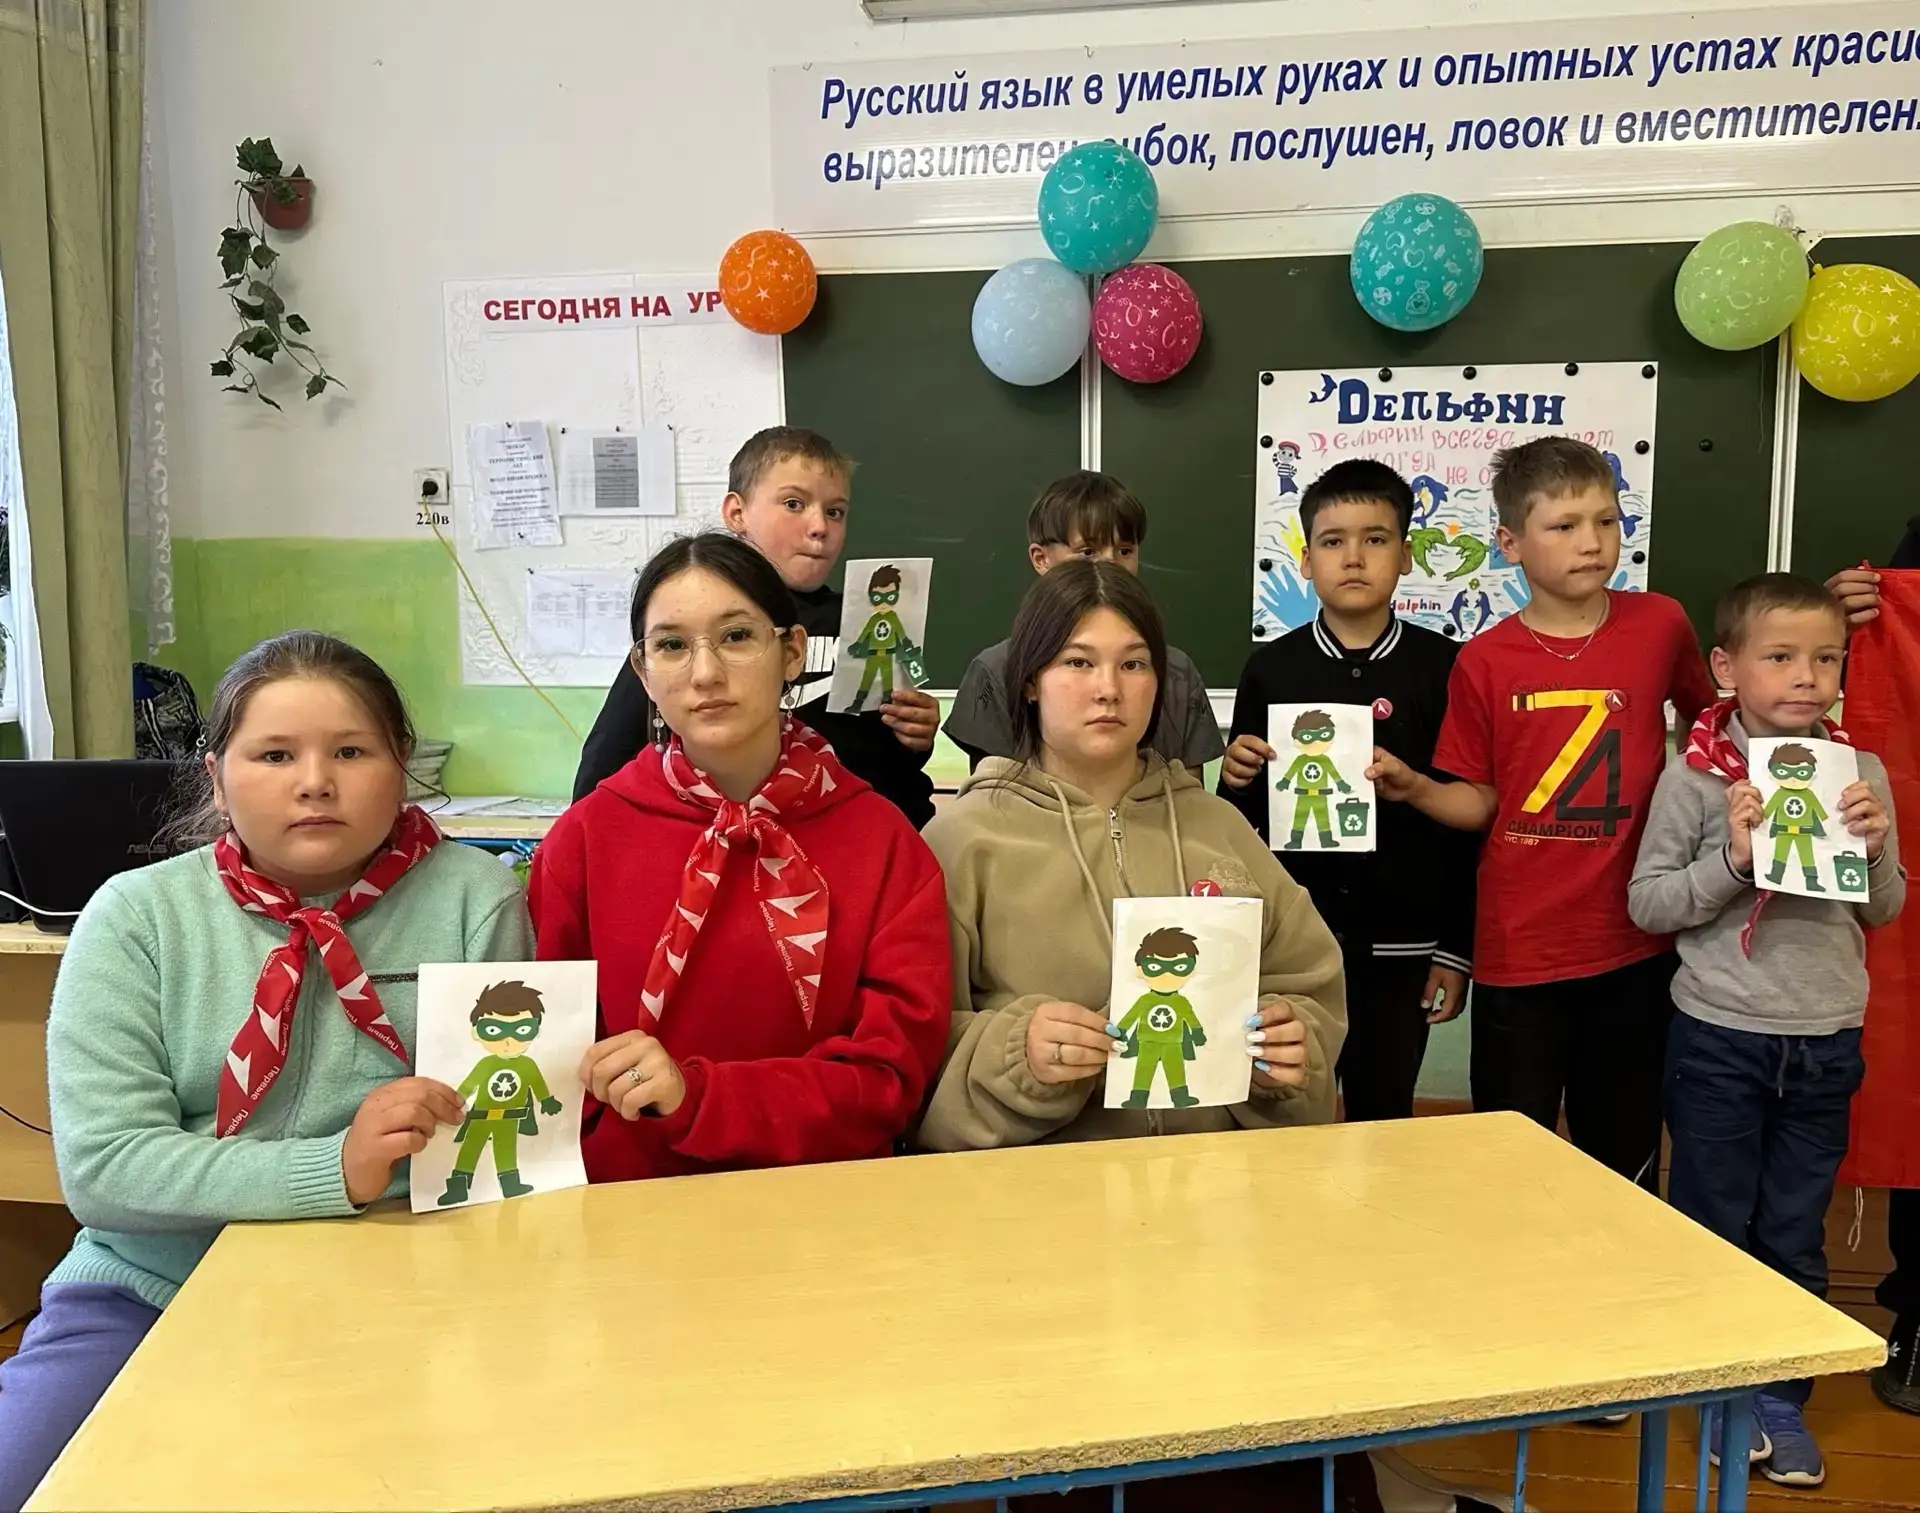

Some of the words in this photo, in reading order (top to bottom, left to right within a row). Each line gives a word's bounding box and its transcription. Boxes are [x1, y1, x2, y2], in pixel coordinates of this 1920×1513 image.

[821, 71, 969, 129] Русский
[979, 76, 1074, 111] язык
[1083, 74, 1103, 105] в
[1115, 65, 1267, 115] умелых
[1275, 58, 1387, 106] руках
[1399, 56, 1422, 89] и
[1434, 44, 1638, 87] опытных
[1647, 36, 1782, 88] устах
[1792, 29, 1920, 77] краси
[1104, 122, 1216, 172] ибок,
[1230, 122, 1434, 169] послушен,
[1446, 115, 1569, 152] ловок
[1580, 113, 1604, 146] и
[483, 297, 621, 324] СЕГОДНЯ
[630, 295, 672, 318] НА
[1507, 819, 1601, 838] CHAMPION
[250, 1065, 281, 1101] Первые
[223, 1108, 249, 1138] Первы
